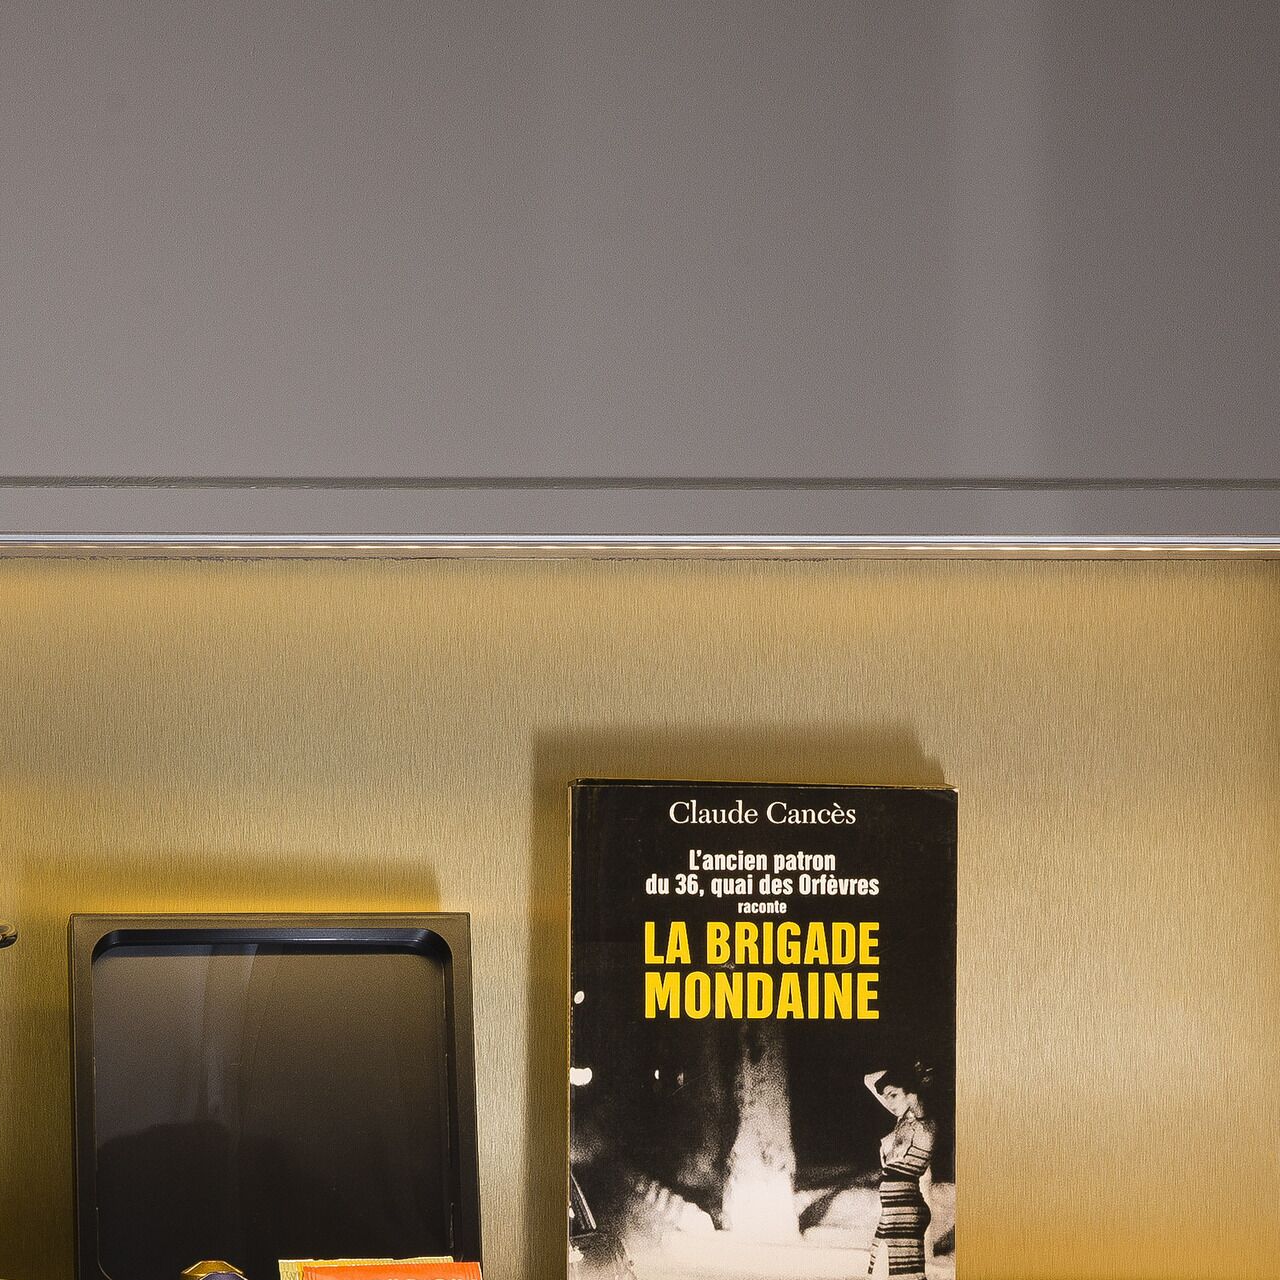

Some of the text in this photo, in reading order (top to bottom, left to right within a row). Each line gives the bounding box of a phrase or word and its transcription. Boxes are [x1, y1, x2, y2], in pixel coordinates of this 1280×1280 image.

[669, 800, 856, 825] Claude Cancès
[773, 853, 836, 874] patron
[645, 874, 880, 897] du 36, quai des Orfèvres
[738, 901, 787, 914] raconte
[645, 922, 880, 965] LA BRIGADE
[645, 972, 880, 1019] MONDAINE
